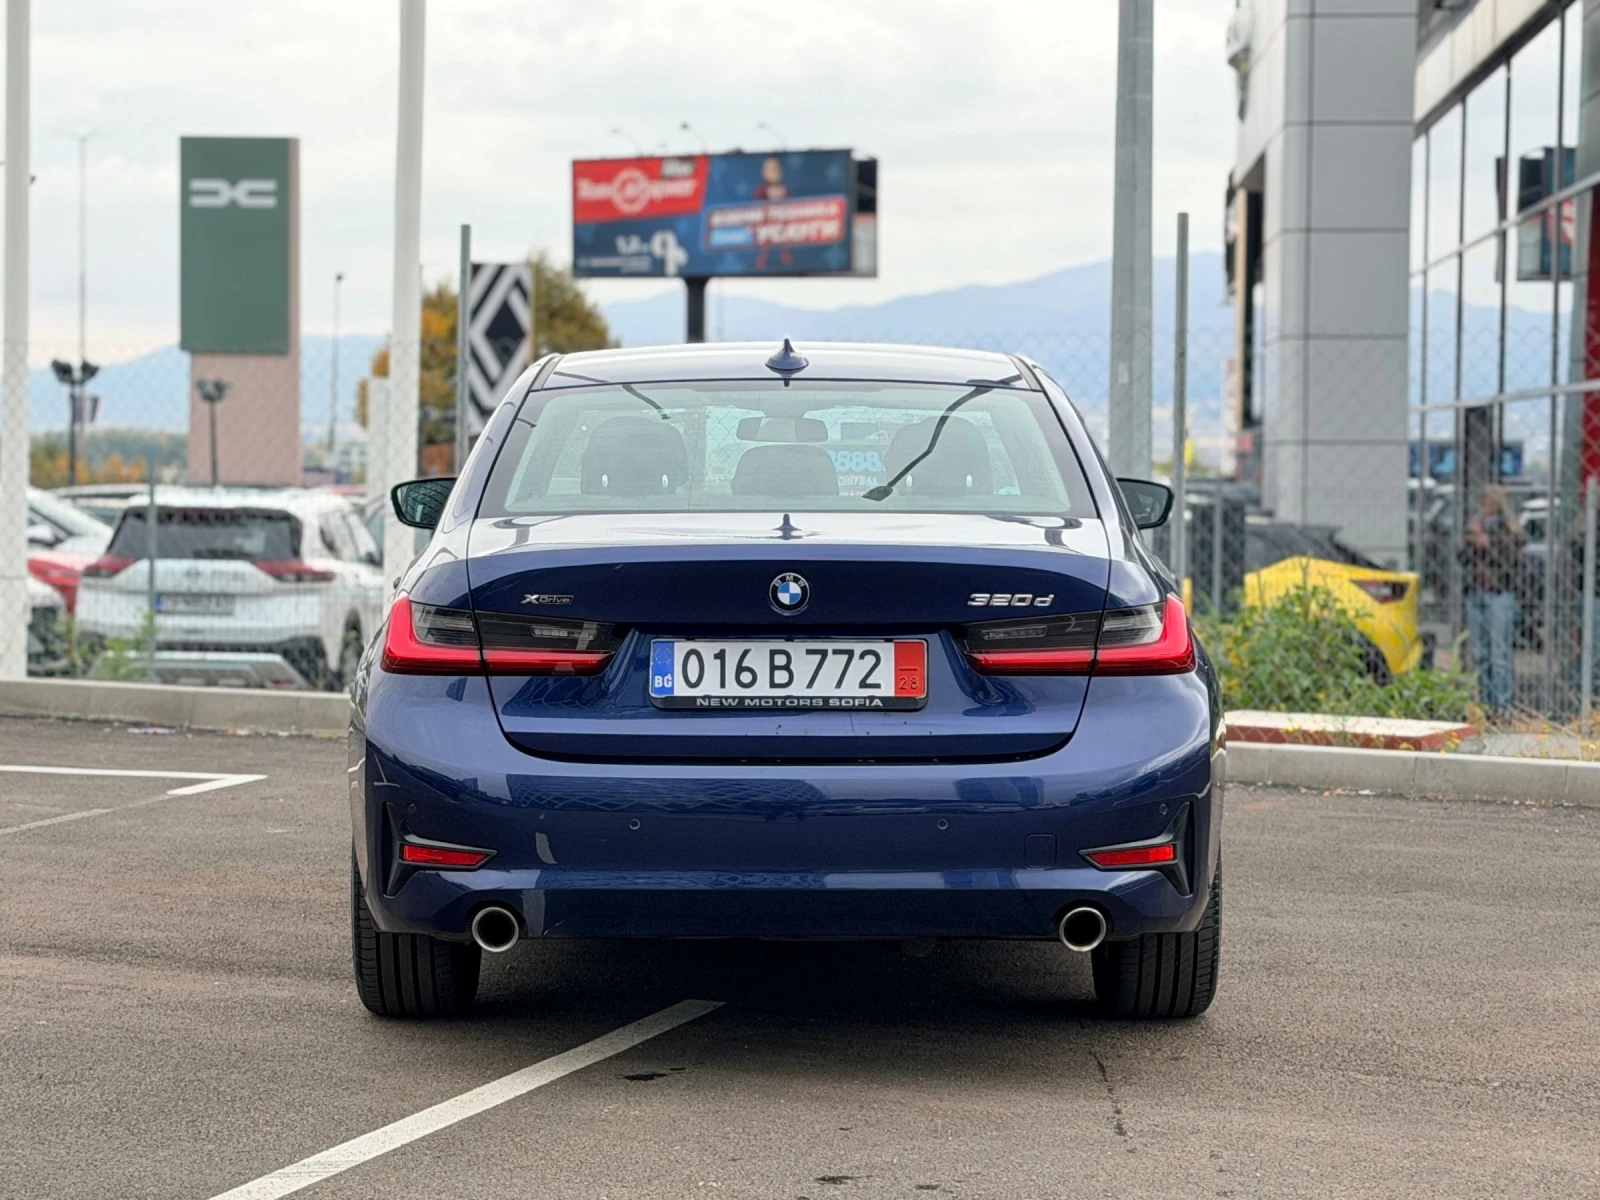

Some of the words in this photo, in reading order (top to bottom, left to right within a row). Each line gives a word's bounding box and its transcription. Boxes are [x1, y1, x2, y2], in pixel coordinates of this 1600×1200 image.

[967, 593, 1055, 607] 320d
[899, 677, 919, 690] 28
[696, 698, 739, 706] NEW
[744, 698, 823, 706] MOTORS
[828, 698, 883, 707] SOFIA
